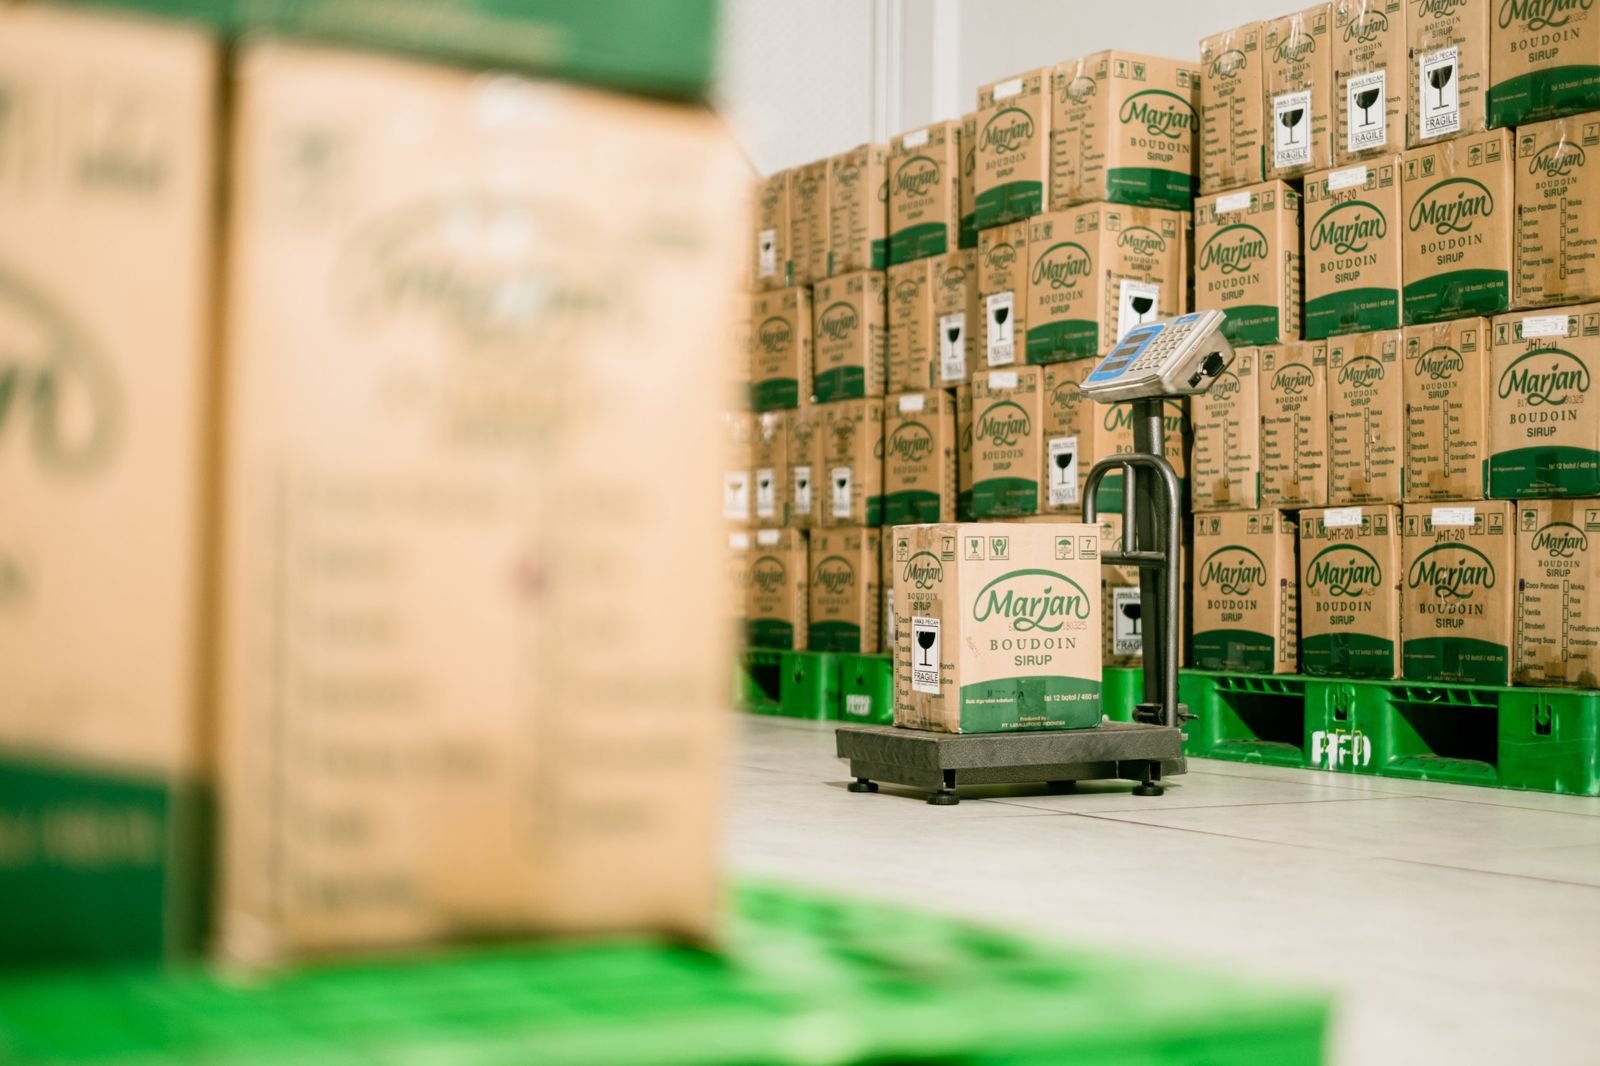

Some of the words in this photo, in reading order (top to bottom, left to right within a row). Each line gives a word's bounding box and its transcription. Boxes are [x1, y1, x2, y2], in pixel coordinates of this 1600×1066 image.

[1424, 16, 1460, 32] BOUDOIN
[1432, 26, 1453, 38] SIRUP
[1510, 28, 1580, 53] BOUDOIN
[1355, 52, 1374, 62] SIRUP
[1528, 48, 1558, 62] SIRUP
[1120, 104, 1199, 139] Marjan
[1426, 114, 1457, 128] FRAGILE
[980, 120, 1034, 154] Marjan
[1352, 131, 1384, 144] FRAGILE
[1130, 137, 1190, 154] BOUDOIN
[986, 152, 1026, 170] BOUDOIN
[1148, 151, 1173, 162] SIRUP
[1276, 149, 1308, 161] FRAGILE
[996, 168, 1014, 178] SIRUP
[1536, 176, 1577, 190] BOUDOIN
[1544, 187, 1568, 198] SIRUP
[1408, 191, 1494, 236] Marjan
[1310, 214, 1387, 254] Marjan
[1117, 234, 1166, 256] Marjan
[1420, 234, 1483, 254] BOUDOIN
[1200, 236, 1268, 274] Marjan
[1436, 252, 1464, 266] SIRUP
[1320, 254, 1377, 273] BOUDOIN
[1032, 254, 1092, 290] Marjan
[1335, 271, 1360, 284] SIRUP
[1208, 274, 1260, 292] BOUDOIN
[1221, 290, 1244, 302] SIRUP
[1415, 354, 1464, 380] Marjan
[1271, 370, 1314, 394] Marjan
[1338, 364, 1384, 388] Marjan
[1421, 382, 1457, 391] BOUDOIN
[1499, 362, 1590, 406] Marjan
[1344, 389, 1378, 400] BOUDOIN
[1428, 390, 1450, 399] SIRUP
[1282, 404, 1301, 412] SIRUP
[1350, 398, 1371, 407] SIRUP
[1211, 410, 1229, 418] SIRUP
[1510, 410, 1577, 424] BOUDOIN
[976, 414, 1030, 446] Marjan
[1526, 426, 1556, 438] SIRUP
[888, 432, 934, 462] Marjan
[1435, 529, 1465, 543] JHT-20
[1531, 531, 1588, 558] Marjan
[903, 562, 943, 590] Marjan
[1200, 558, 1266, 595] Marjan
[1306, 558, 1382, 597] Marjan
[1408, 558, 1495, 599] Marjan
[1546, 569, 1571, 577] SIRUP
[913, 601, 931, 611] SIRUP
[973, 586, 1090, 632] Marjan
[1208, 600, 1257, 610] BOUDOIN
[1316, 601, 1372, 612] BOUDOIN
[1420, 604, 1483, 615] BOUDOIN
[1221, 613, 1242, 622] SIRUP
[1330, 616, 1355, 625] SIRUP
[1436, 618, 1464, 629] SIRUP
[990, 637, 1076, 651] BOUDOIN
[1014, 655, 1052, 666] SIRUP
[914, 671, 938, 682] FRAGILE
